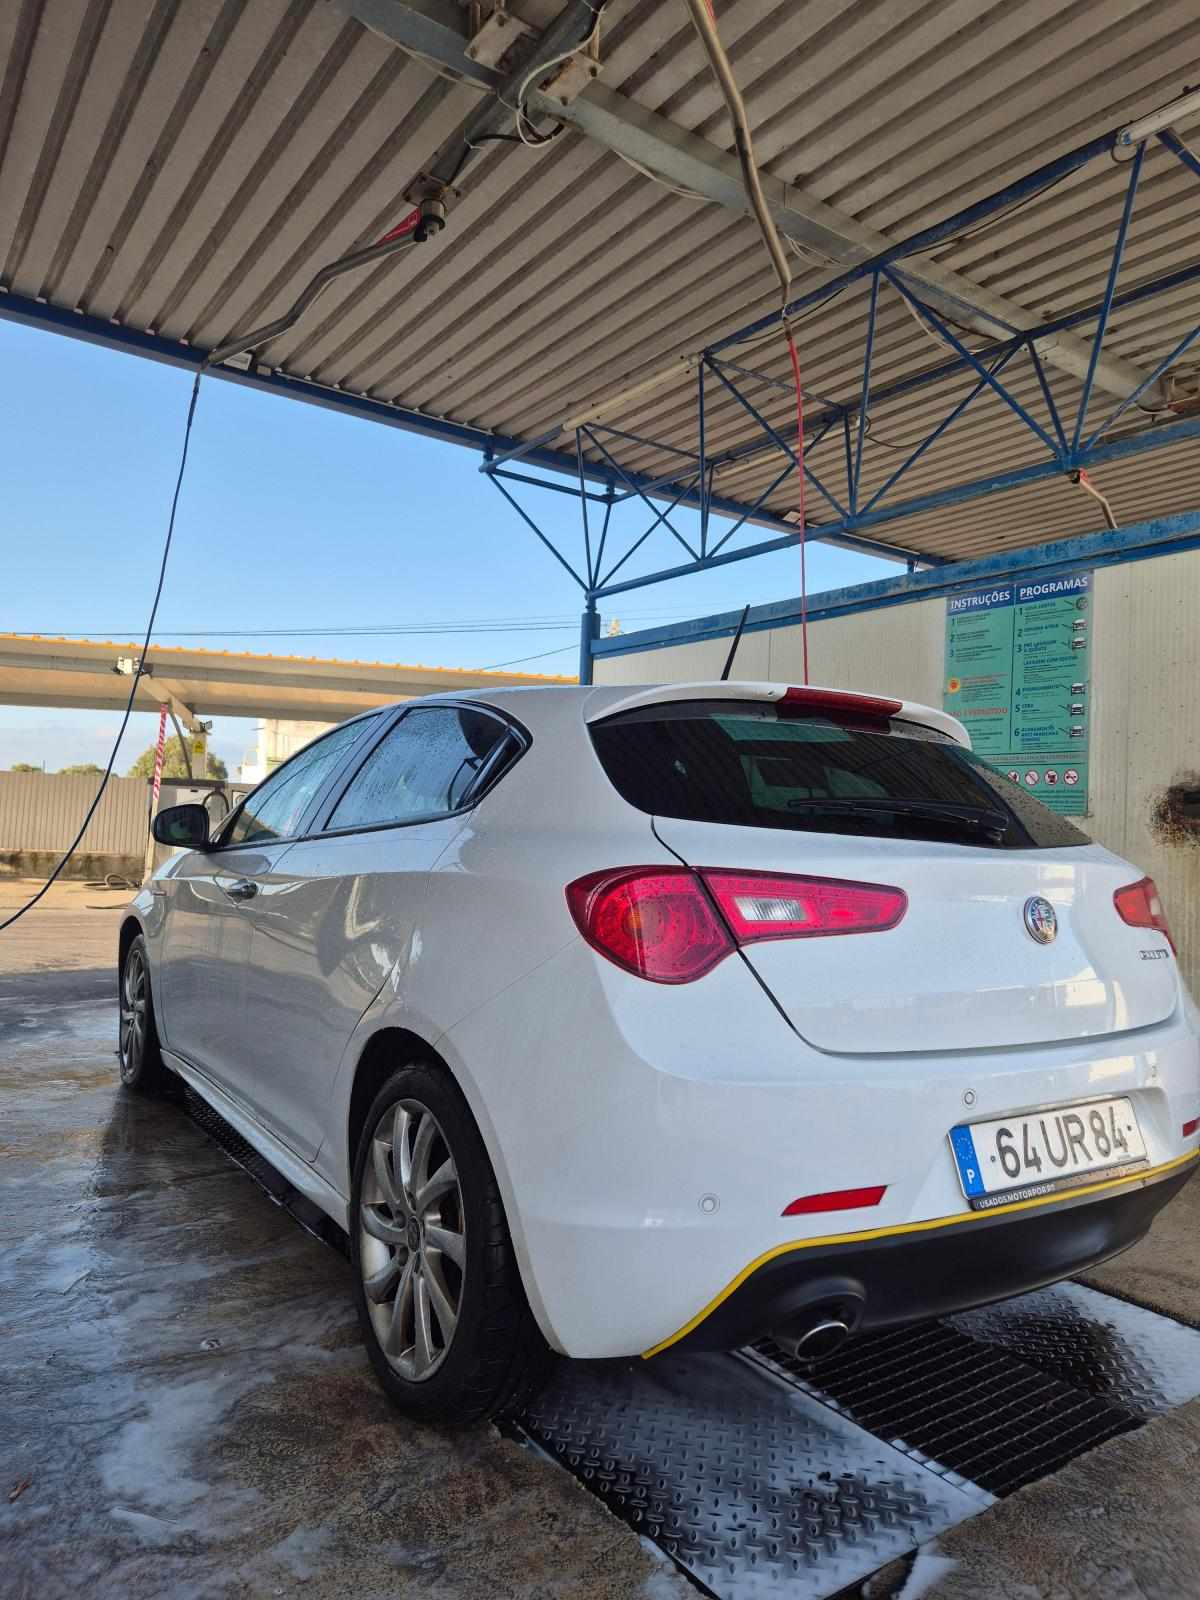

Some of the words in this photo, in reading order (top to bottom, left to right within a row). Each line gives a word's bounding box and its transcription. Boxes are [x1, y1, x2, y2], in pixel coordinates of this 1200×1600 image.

[1019, 577, 1088, 598] PROGRAMAS
[951, 590, 1011, 610] INSTRUÇÕES
[1015, 703, 1021, 713] 5
[1013, 728, 1020, 737] 6
[966, 1168, 977, 1185] P
